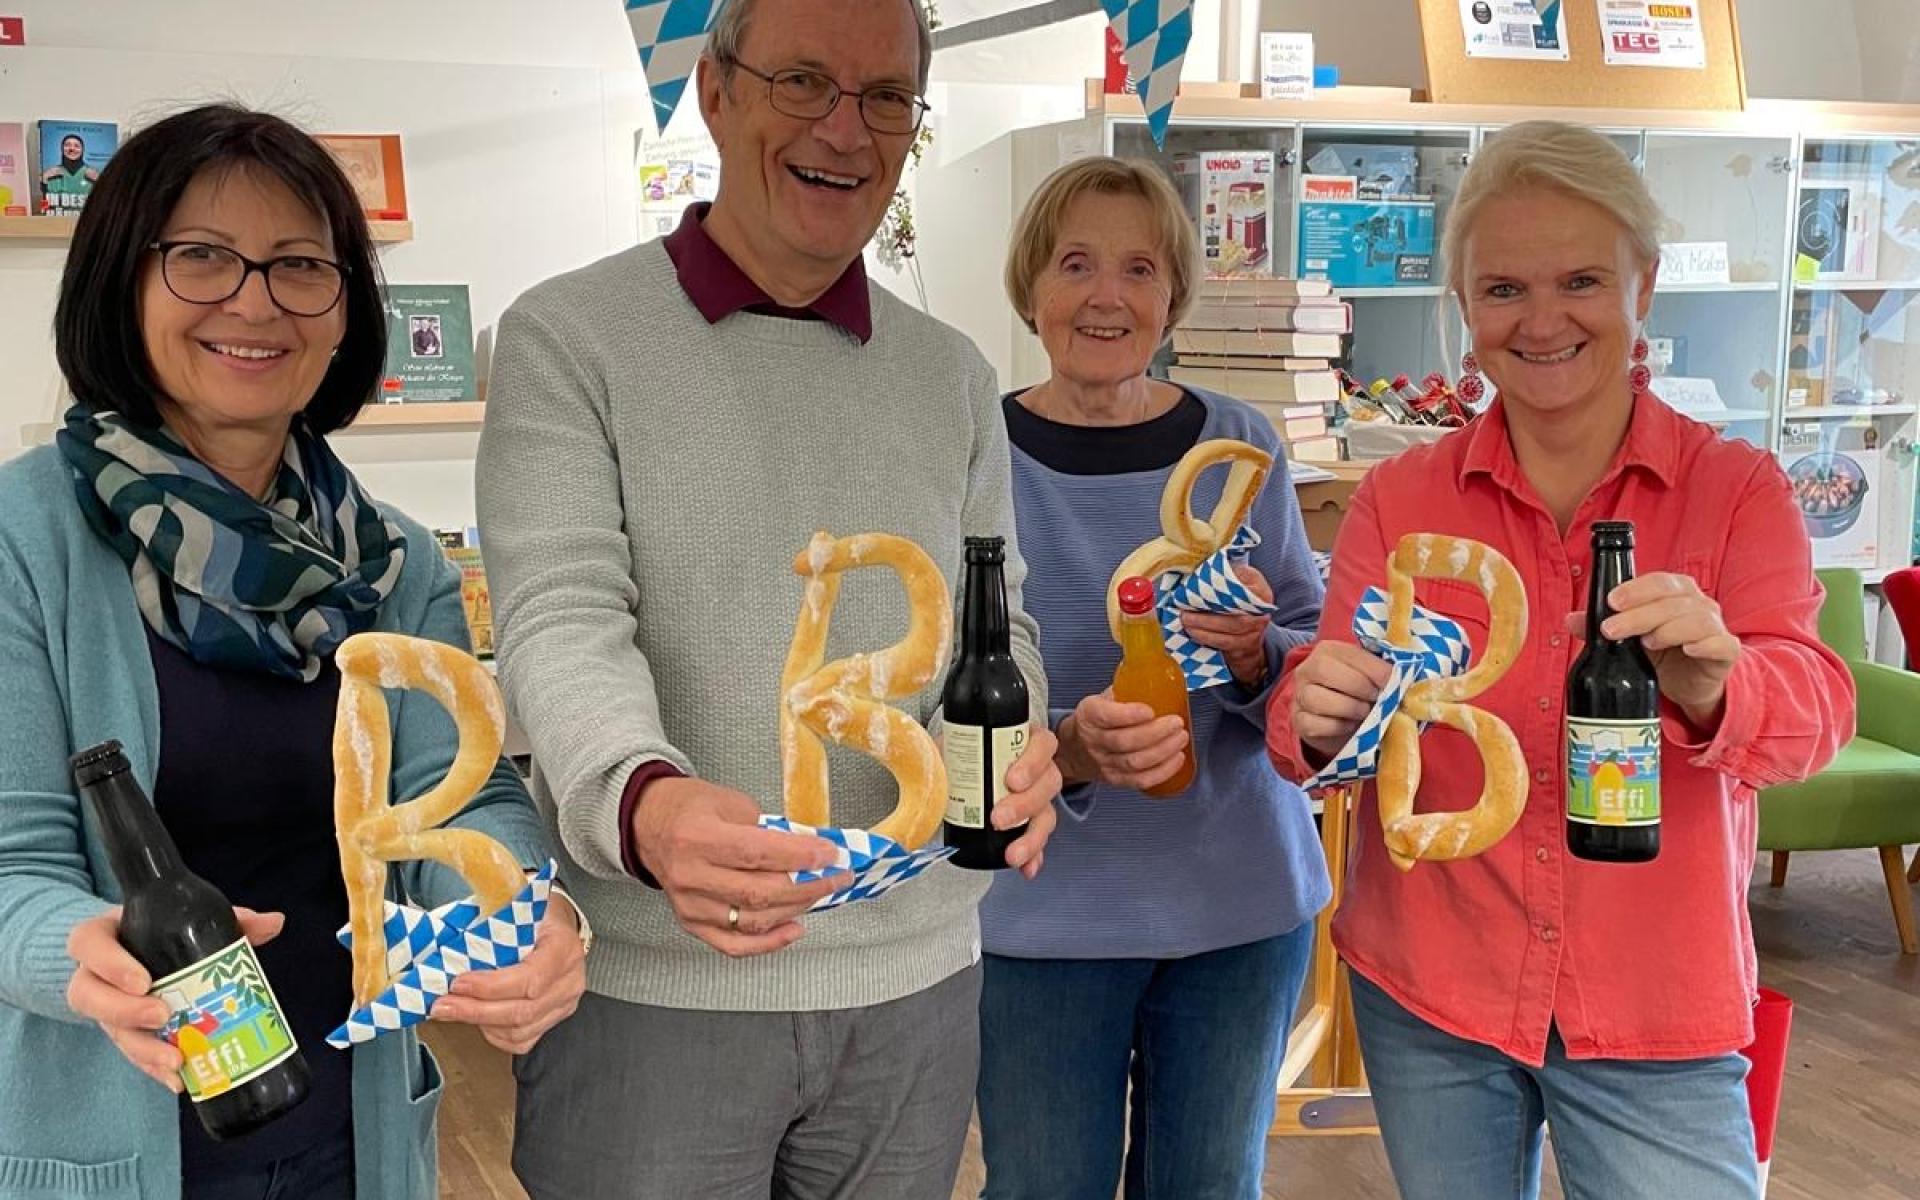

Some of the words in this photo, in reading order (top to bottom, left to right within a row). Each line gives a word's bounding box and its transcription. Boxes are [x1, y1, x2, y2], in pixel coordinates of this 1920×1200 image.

[1613, 32, 1659, 48] TEC
[1206, 159, 1241, 171] UNOLD
[61, 193, 88, 207] BES
[1600, 788, 1645, 809] Effi
[191, 1037, 247, 1079] Effi
